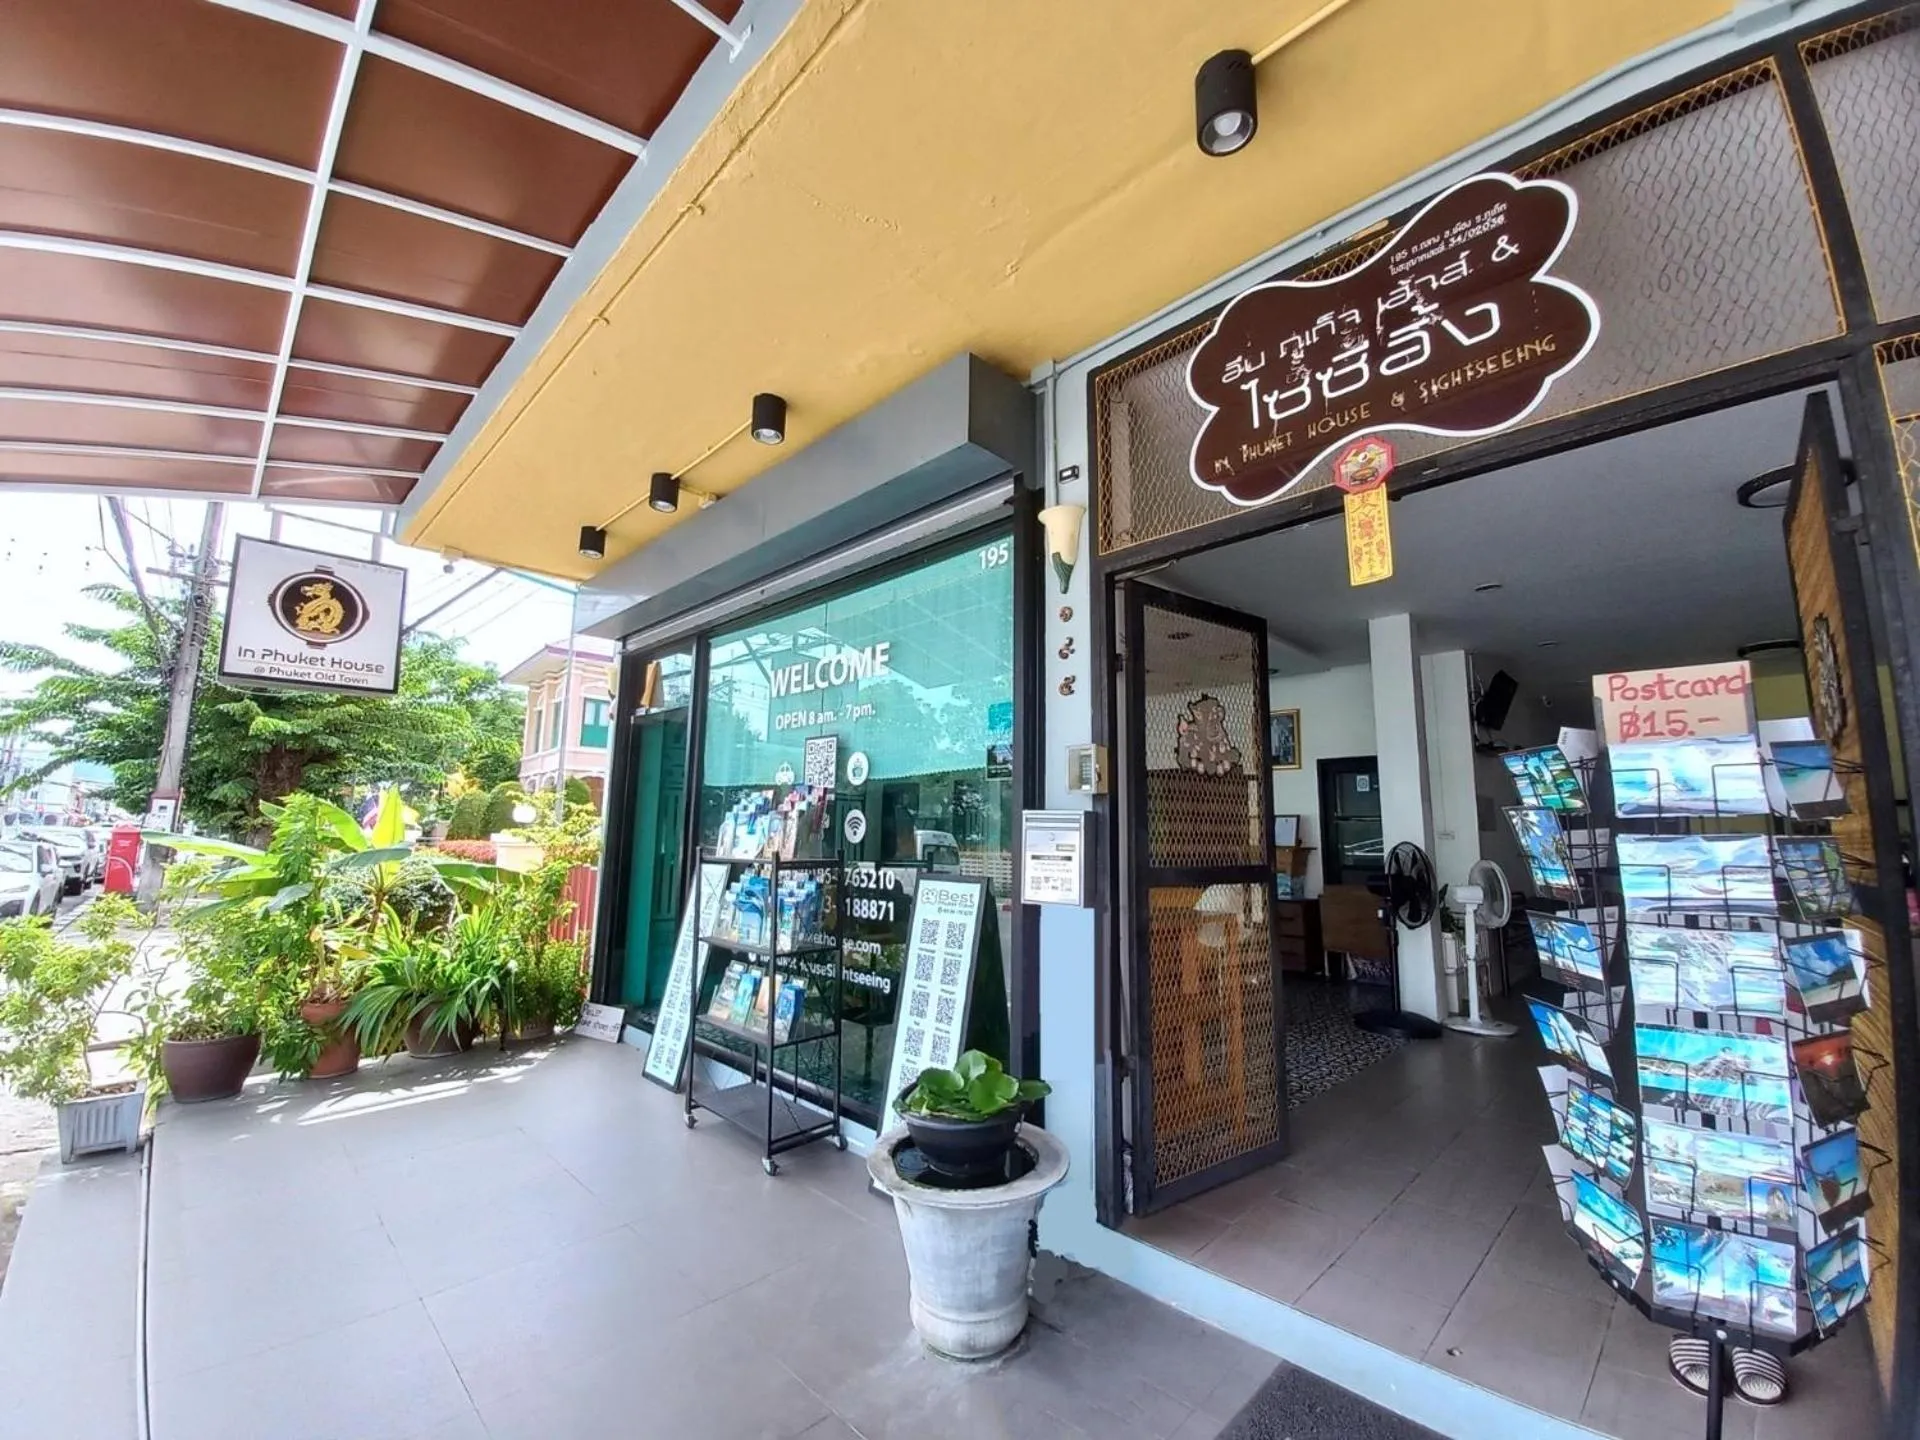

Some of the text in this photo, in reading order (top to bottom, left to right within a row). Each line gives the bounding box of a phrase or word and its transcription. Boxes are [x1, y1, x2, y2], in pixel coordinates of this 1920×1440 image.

[1491, 235, 1520, 262] &
[1307, 402, 1371, 439] HOUSE
[1418, 334, 1556, 400] SIGHTSEEING
[979, 543, 1008, 569] 195
[238, 646, 385, 674] In Phuket House
[771, 642, 890, 698] WELCOME
[268, 666, 312, 680] Phuket
[314, 671, 336, 681] Old
[339, 675, 369, 685] Town
[1607, 664, 1747, 701] Postcard
[775, 710, 807, 730] OPEN
[939, 889, 974, 903] Best
